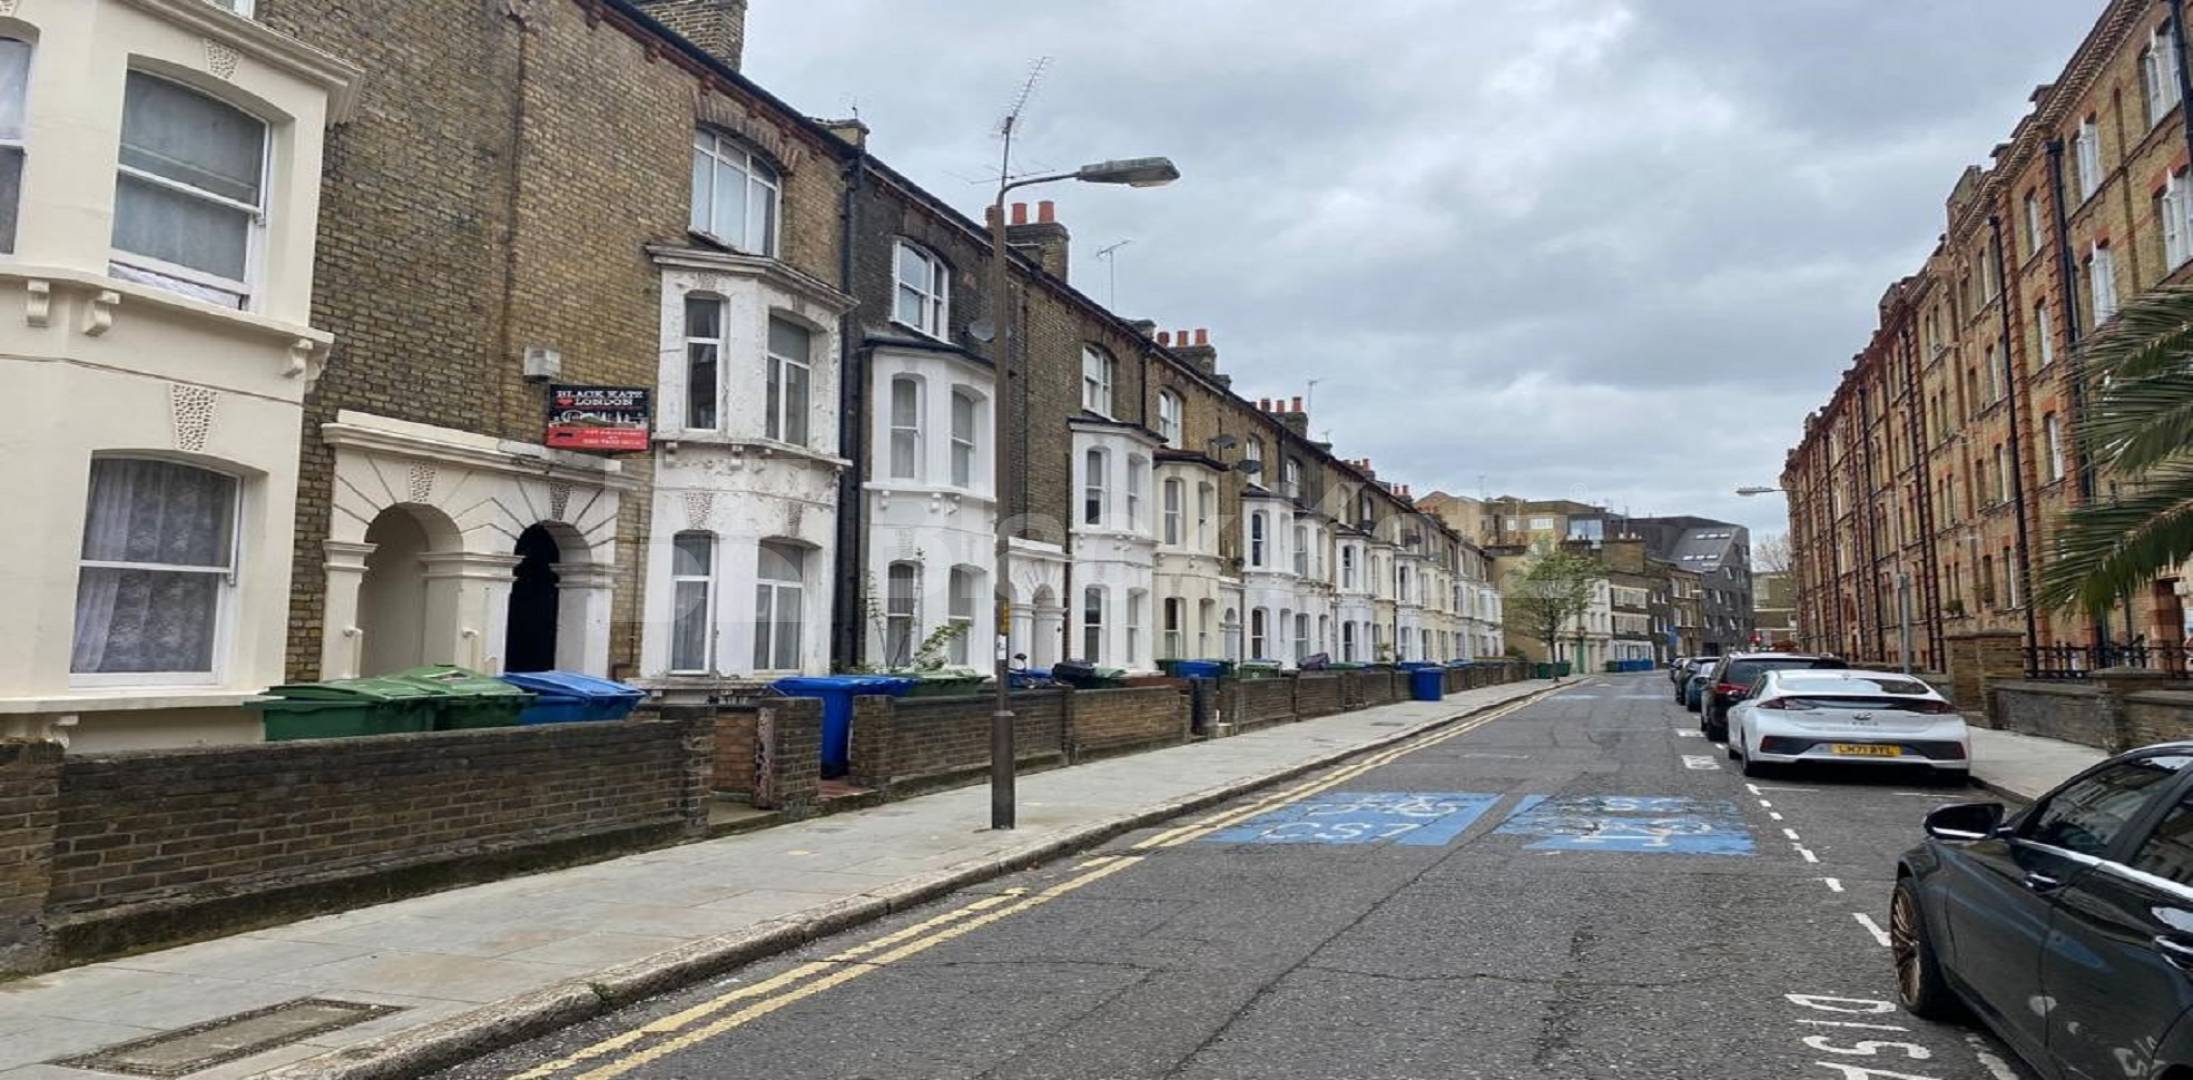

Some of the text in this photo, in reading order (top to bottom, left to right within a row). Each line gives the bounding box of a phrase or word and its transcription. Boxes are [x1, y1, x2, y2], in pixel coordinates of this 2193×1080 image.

[555, 390, 604, 399] BLACK
[574, 398, 634, 406] LONDON
[1260, 822, 1424, 839] CS7
